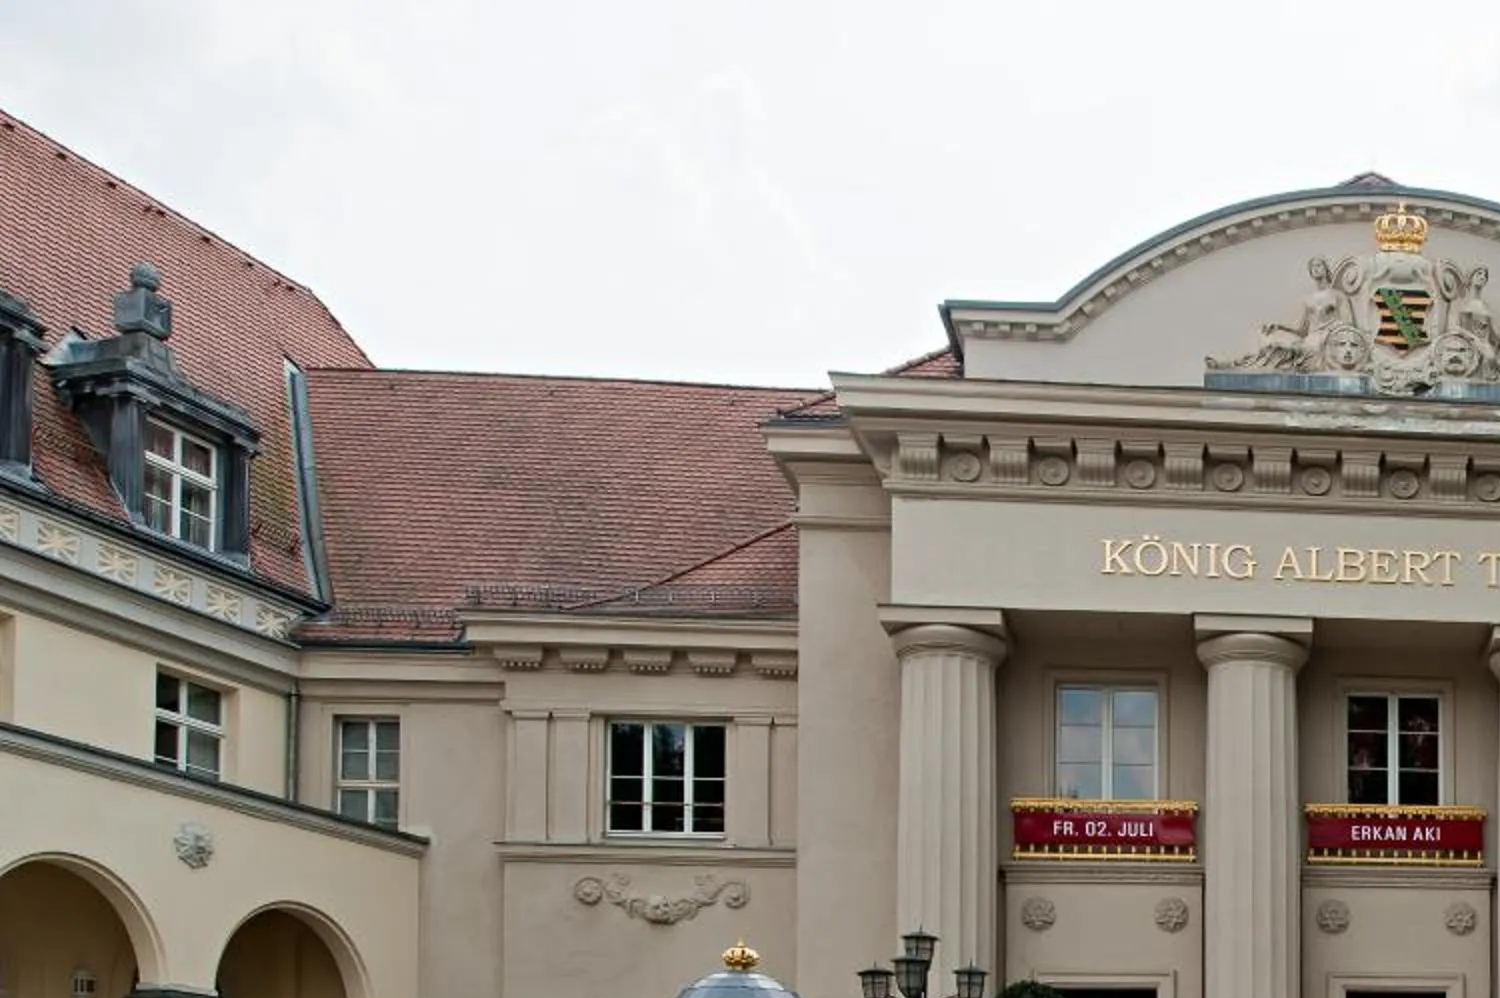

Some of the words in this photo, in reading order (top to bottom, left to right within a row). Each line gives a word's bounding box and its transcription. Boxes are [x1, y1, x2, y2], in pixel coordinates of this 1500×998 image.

[1101, 534, 1258, 580] KÖNIG
[1273, 545, 1461, 586] ALBERT
[1053, 820, 1079, 836] FR.
[1085, 821, 1112, 837] 02.
[1117, 821, 1154, 837] JULI
[1351, 825, 1407, 841] ERKAN
[1412, 826, 1441, 841] AKI
